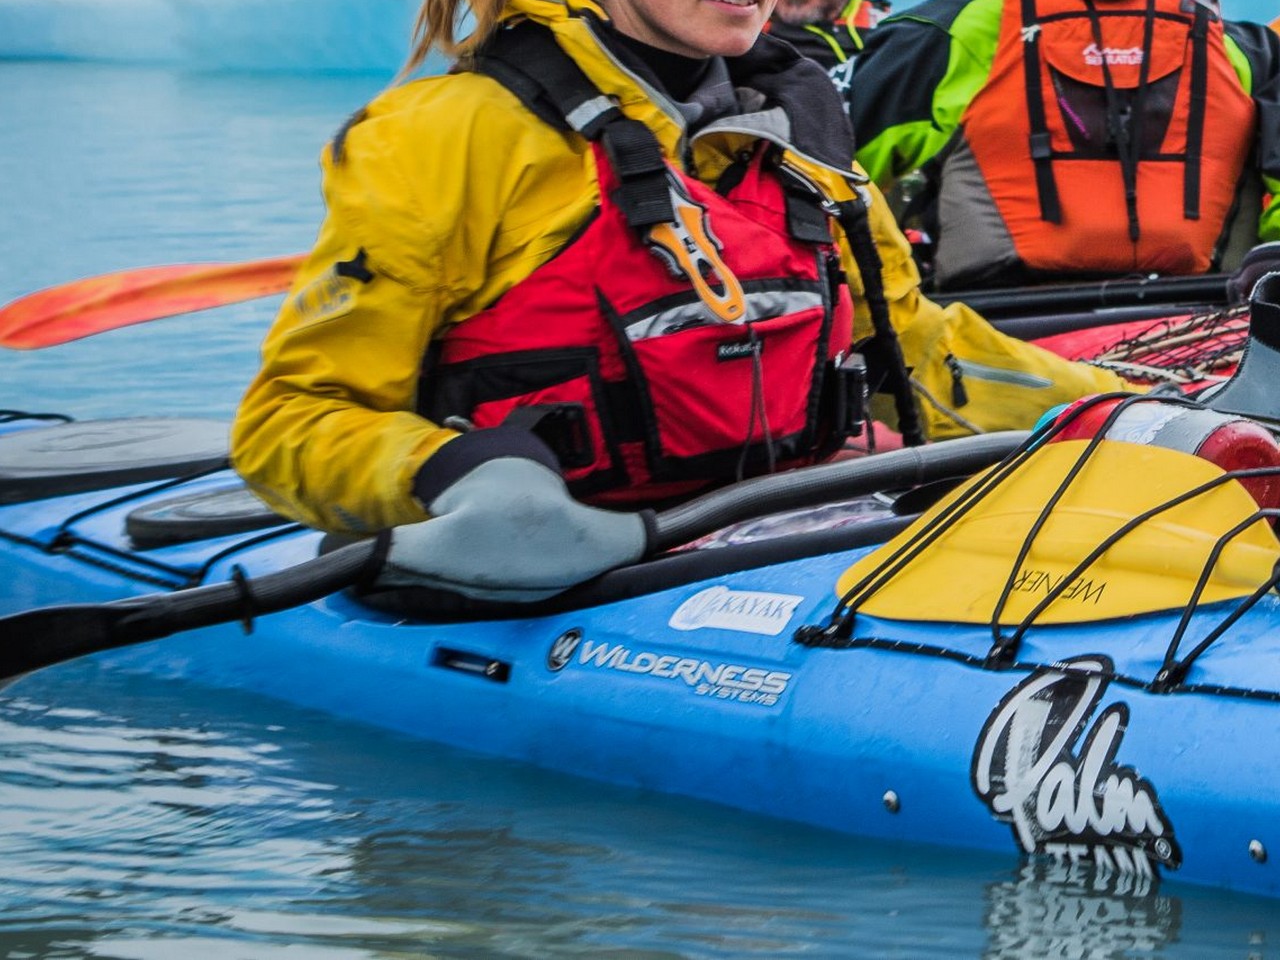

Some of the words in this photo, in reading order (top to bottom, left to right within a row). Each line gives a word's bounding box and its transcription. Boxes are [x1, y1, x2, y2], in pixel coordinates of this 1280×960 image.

[1012, 570, 1107, 604] WENER
[717, 595, 791, 620] KAYAK
[579, 640, 791, 693] WILDERNESS
[695, 684, 780, 707] SYSTEMS
[977, 660, 1164, 852] Palm
